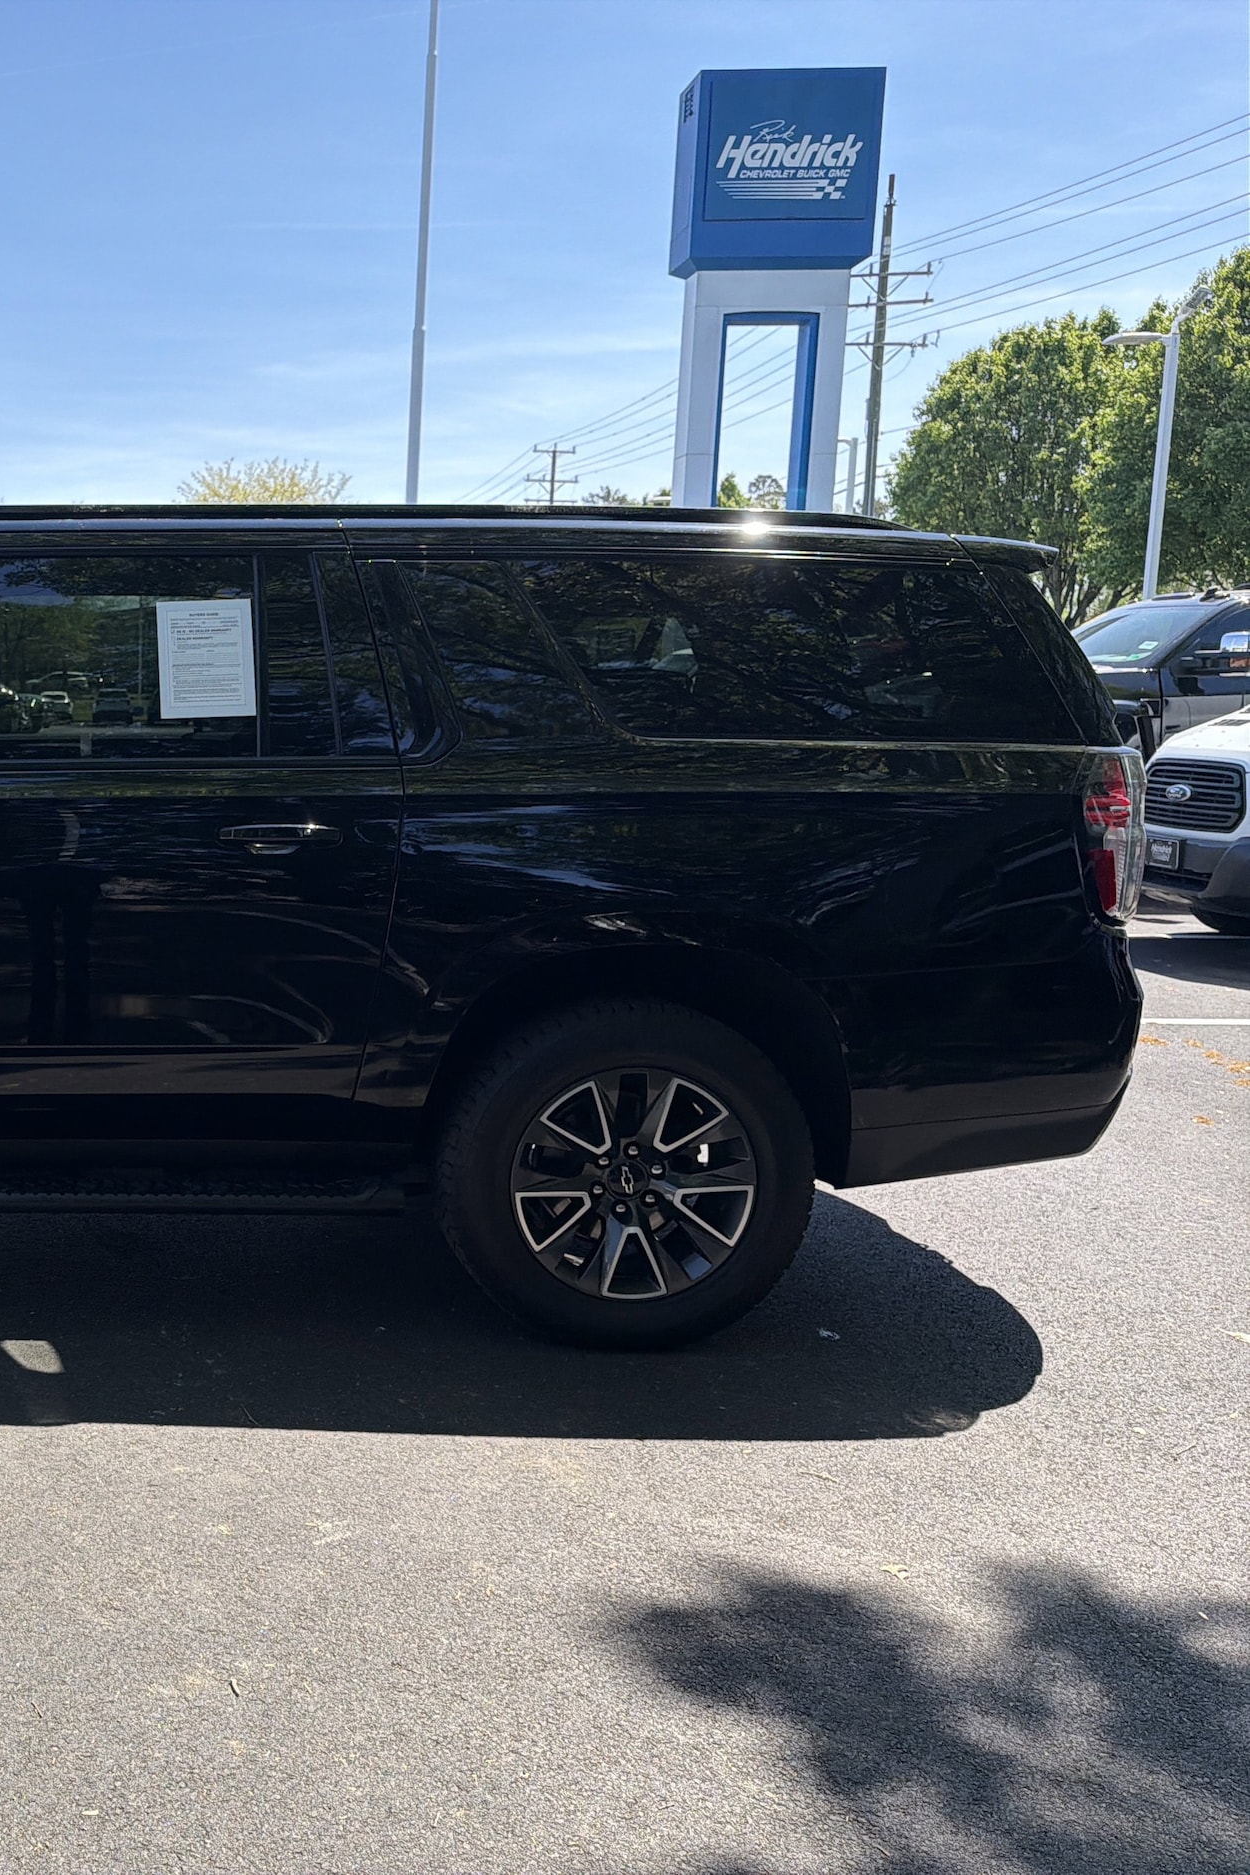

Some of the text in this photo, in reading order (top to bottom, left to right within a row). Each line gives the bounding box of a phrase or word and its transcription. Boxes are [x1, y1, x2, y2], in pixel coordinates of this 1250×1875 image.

[716, 133, 864, 179] Hendrick
[739, 168, 852, 179] CHEVROLET BUICK GMC
